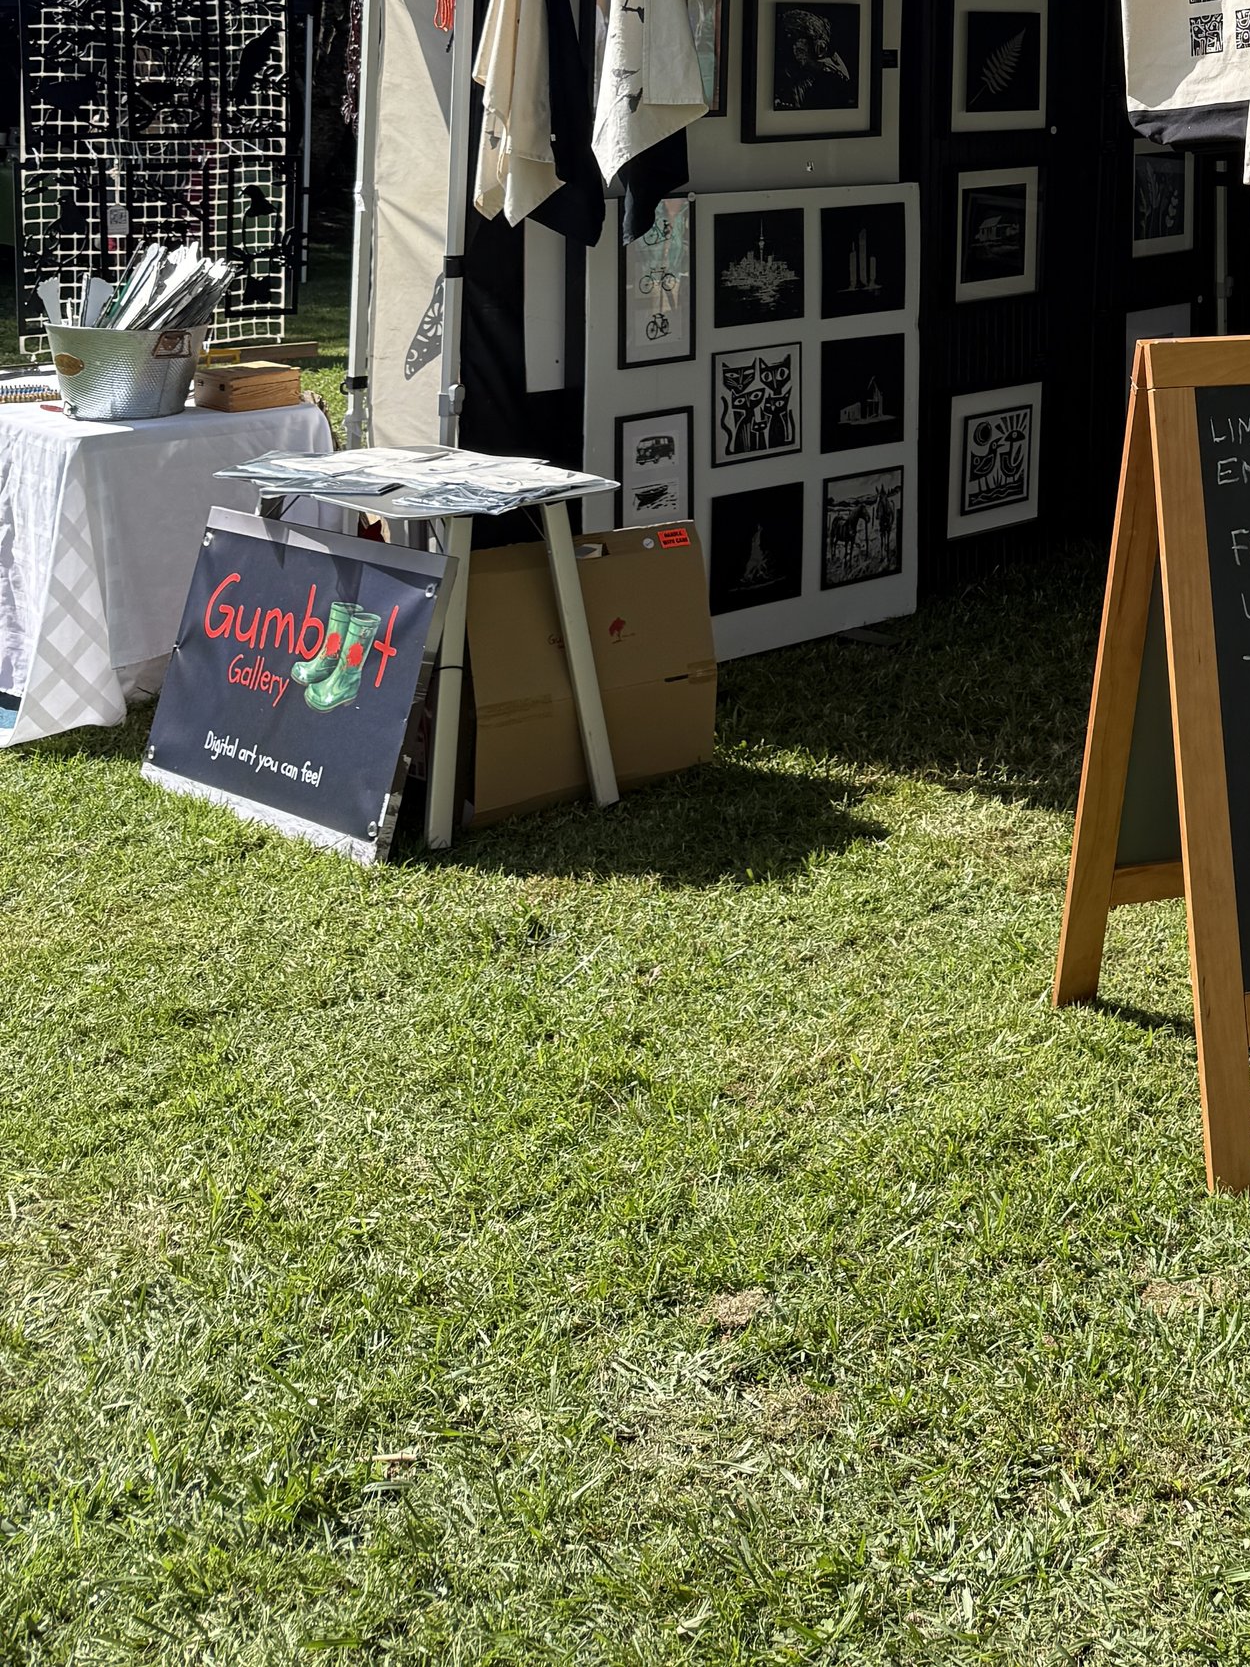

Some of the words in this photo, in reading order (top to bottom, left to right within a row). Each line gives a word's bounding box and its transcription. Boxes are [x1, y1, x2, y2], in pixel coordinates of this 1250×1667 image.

[227, 653, 290, 708] Gallery
[203, 730, 240, 761] Digital
[238, 744, 258, 766] art
[254, 754, 279, 773] you
[280, 761, 299, 781] can
[300, 760, 324, 788] feel
